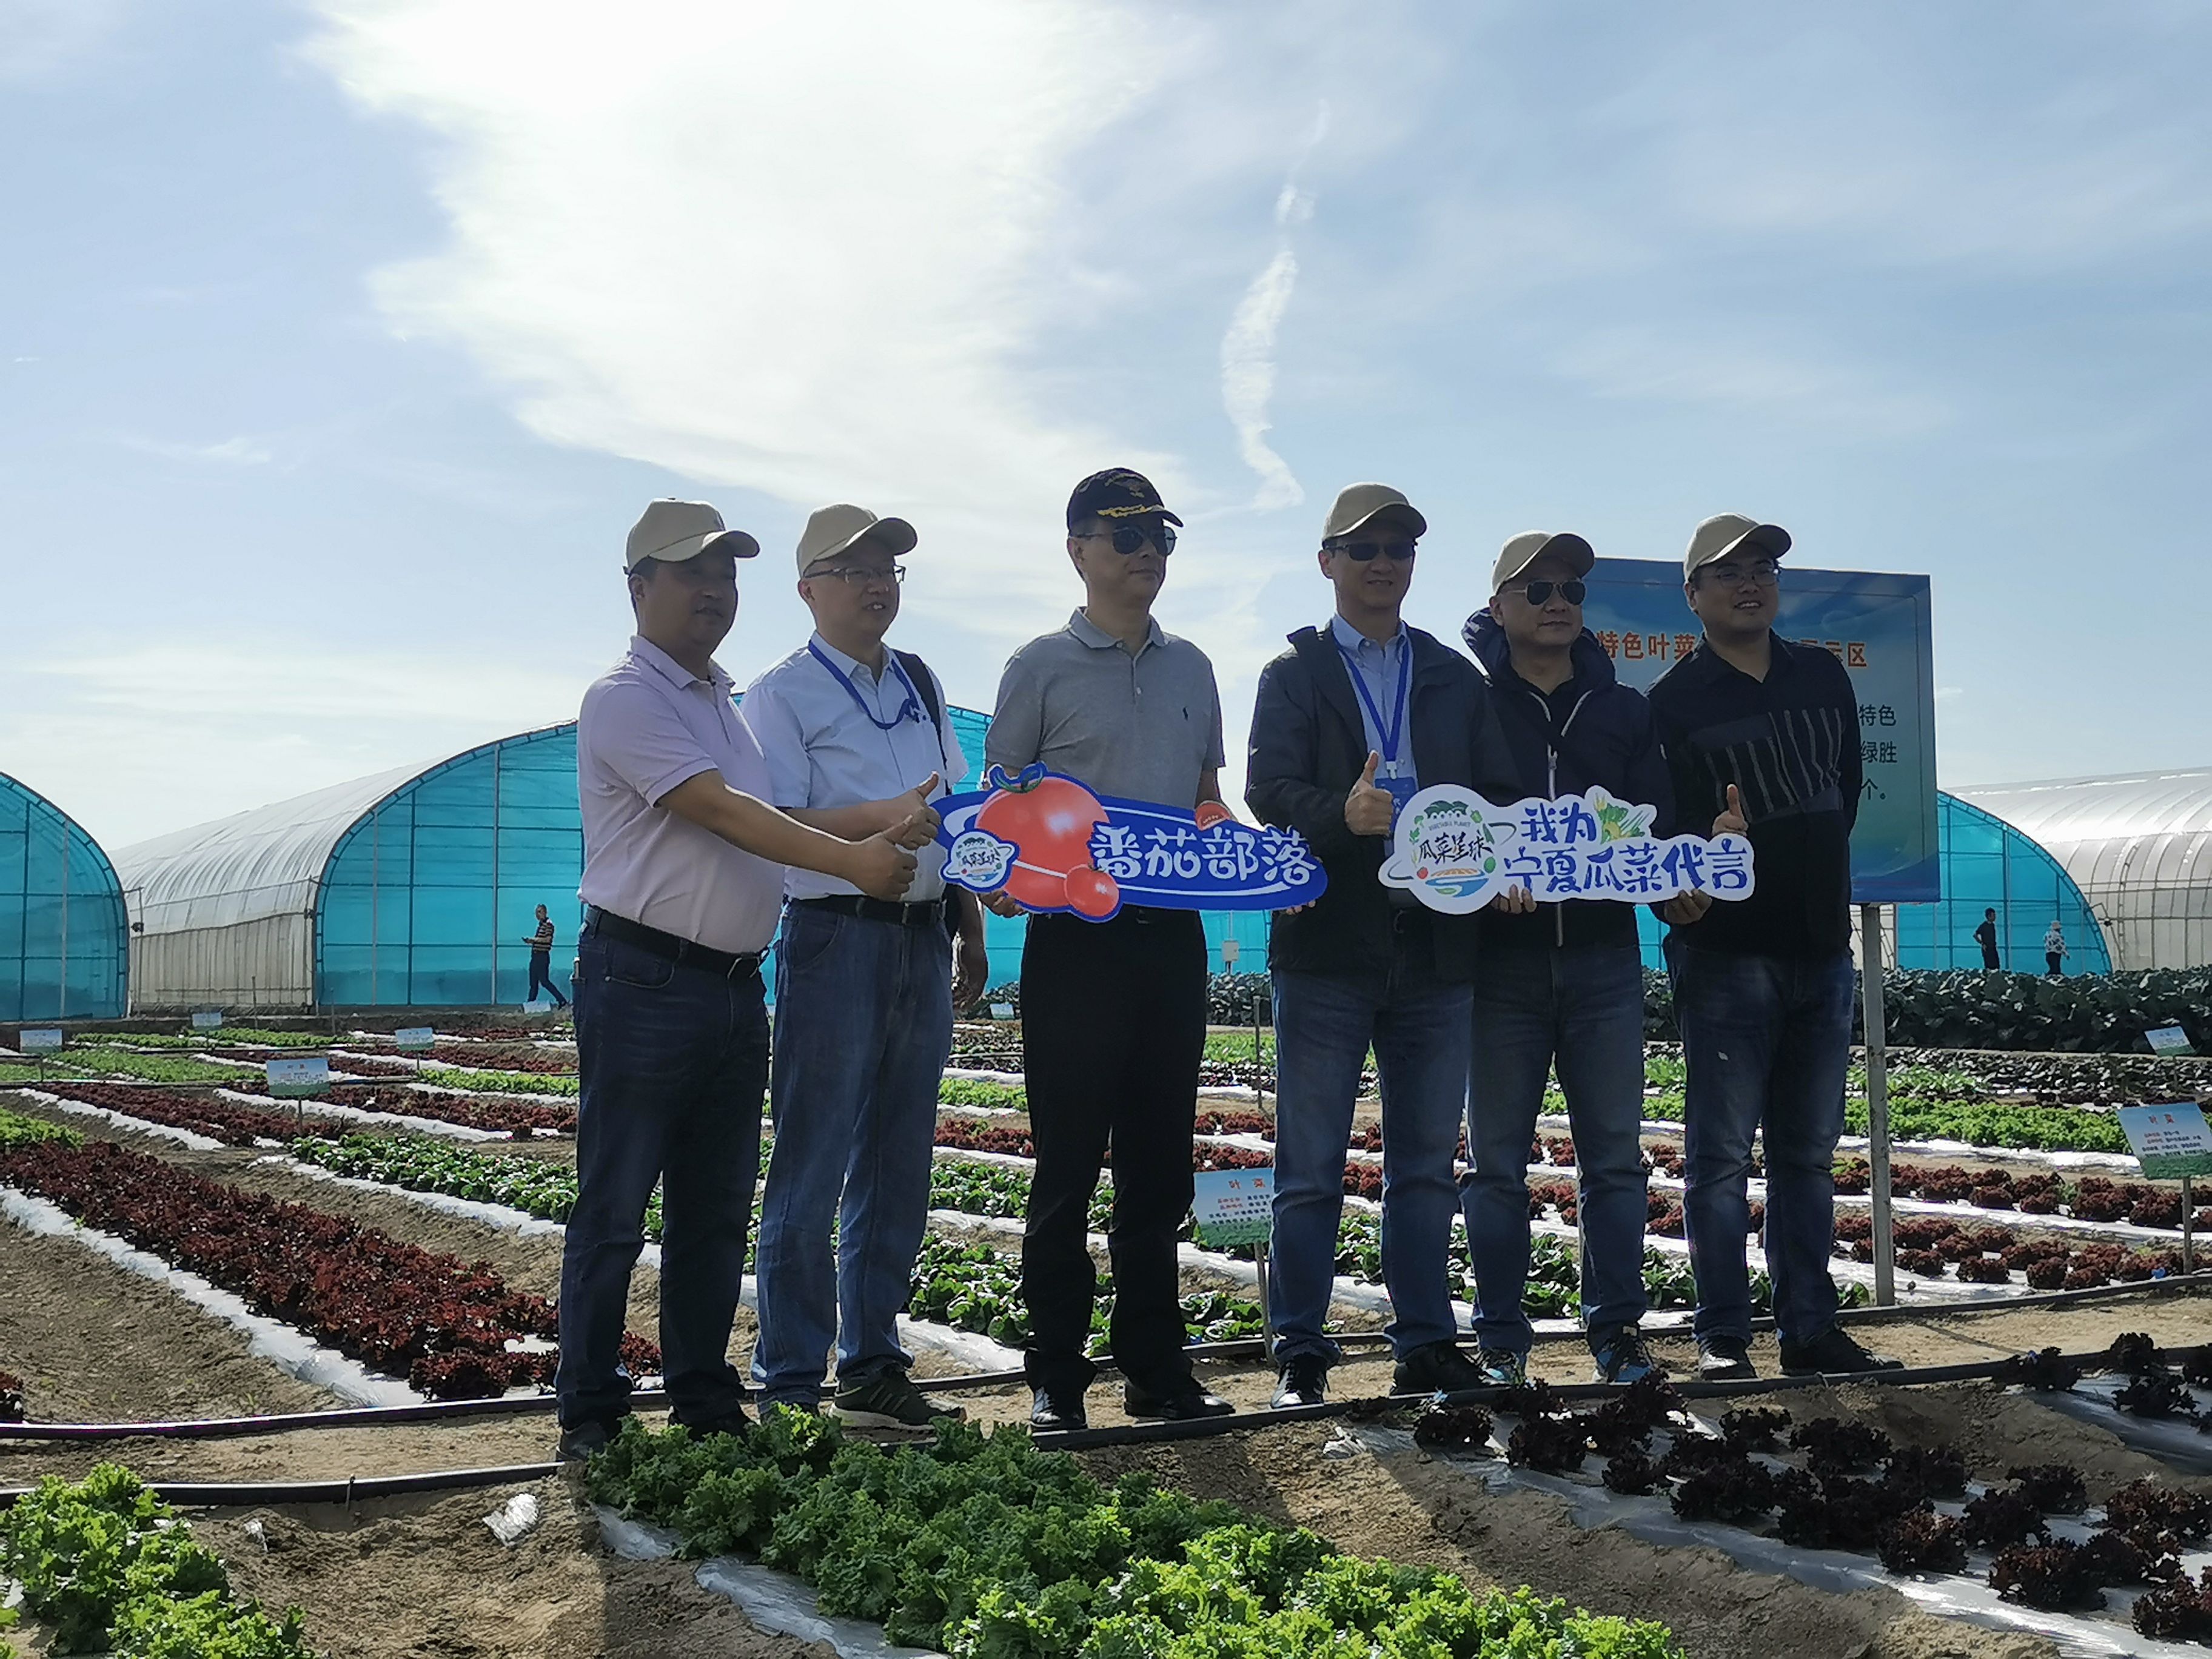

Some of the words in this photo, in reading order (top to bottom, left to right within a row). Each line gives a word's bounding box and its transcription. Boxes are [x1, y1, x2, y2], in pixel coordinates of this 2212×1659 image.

[1858, 704, 1897, 726] 特色
[1861, 740, 1898, 763] 绿胜
[1520, 802, 1597, 844] 我为
[1090, 825, 1318, 885] 番茄部落
[1418, 830, 1494, 865] 瓜菜星球
[1503, 837, 1748, 893] 宁夏瓜菜代言
